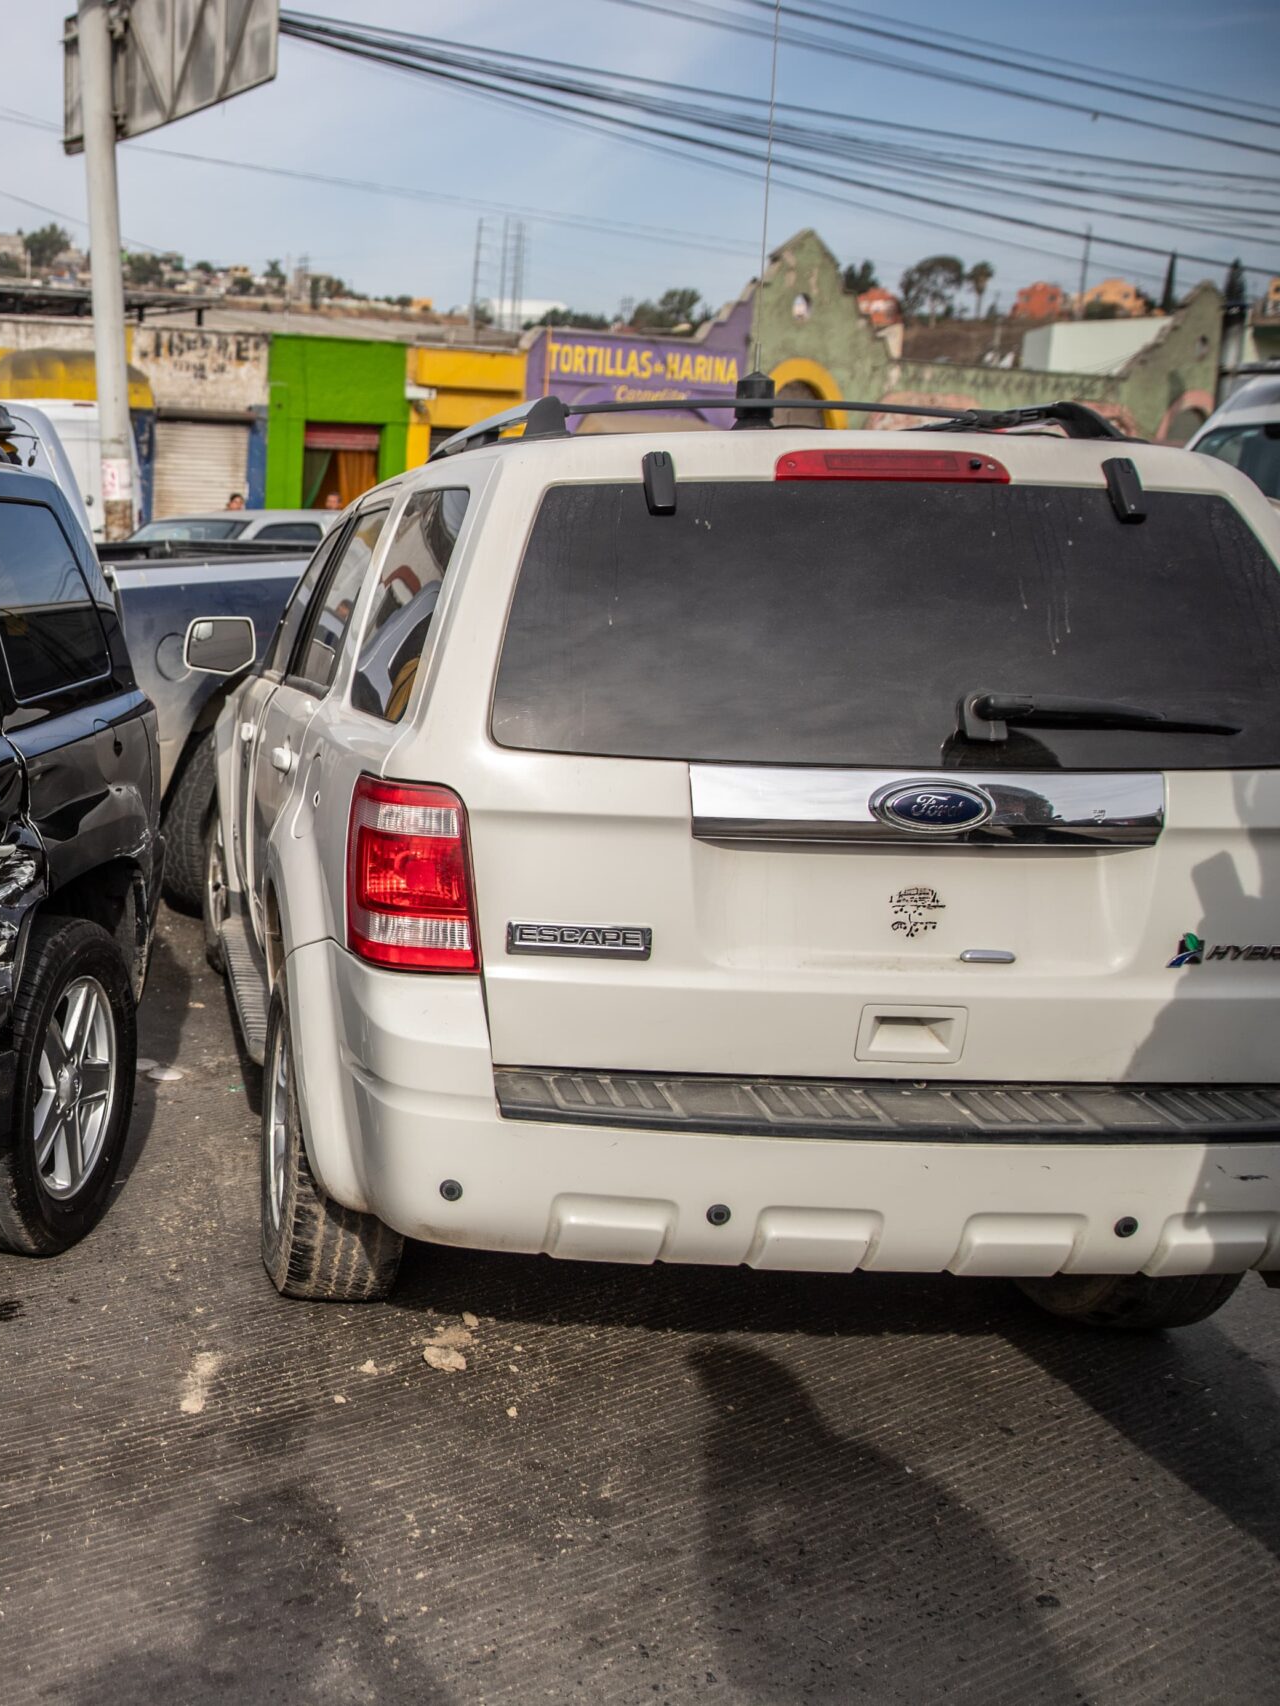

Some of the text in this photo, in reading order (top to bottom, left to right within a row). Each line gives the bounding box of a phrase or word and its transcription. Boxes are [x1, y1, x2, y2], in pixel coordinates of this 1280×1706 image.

[549, 343, 653, 379] TORTILLAS
[666, 352, 739, 385] HARINA
[912, 795, 966, 817] Ford
[519, 926, 643, 948] ESCAPE
